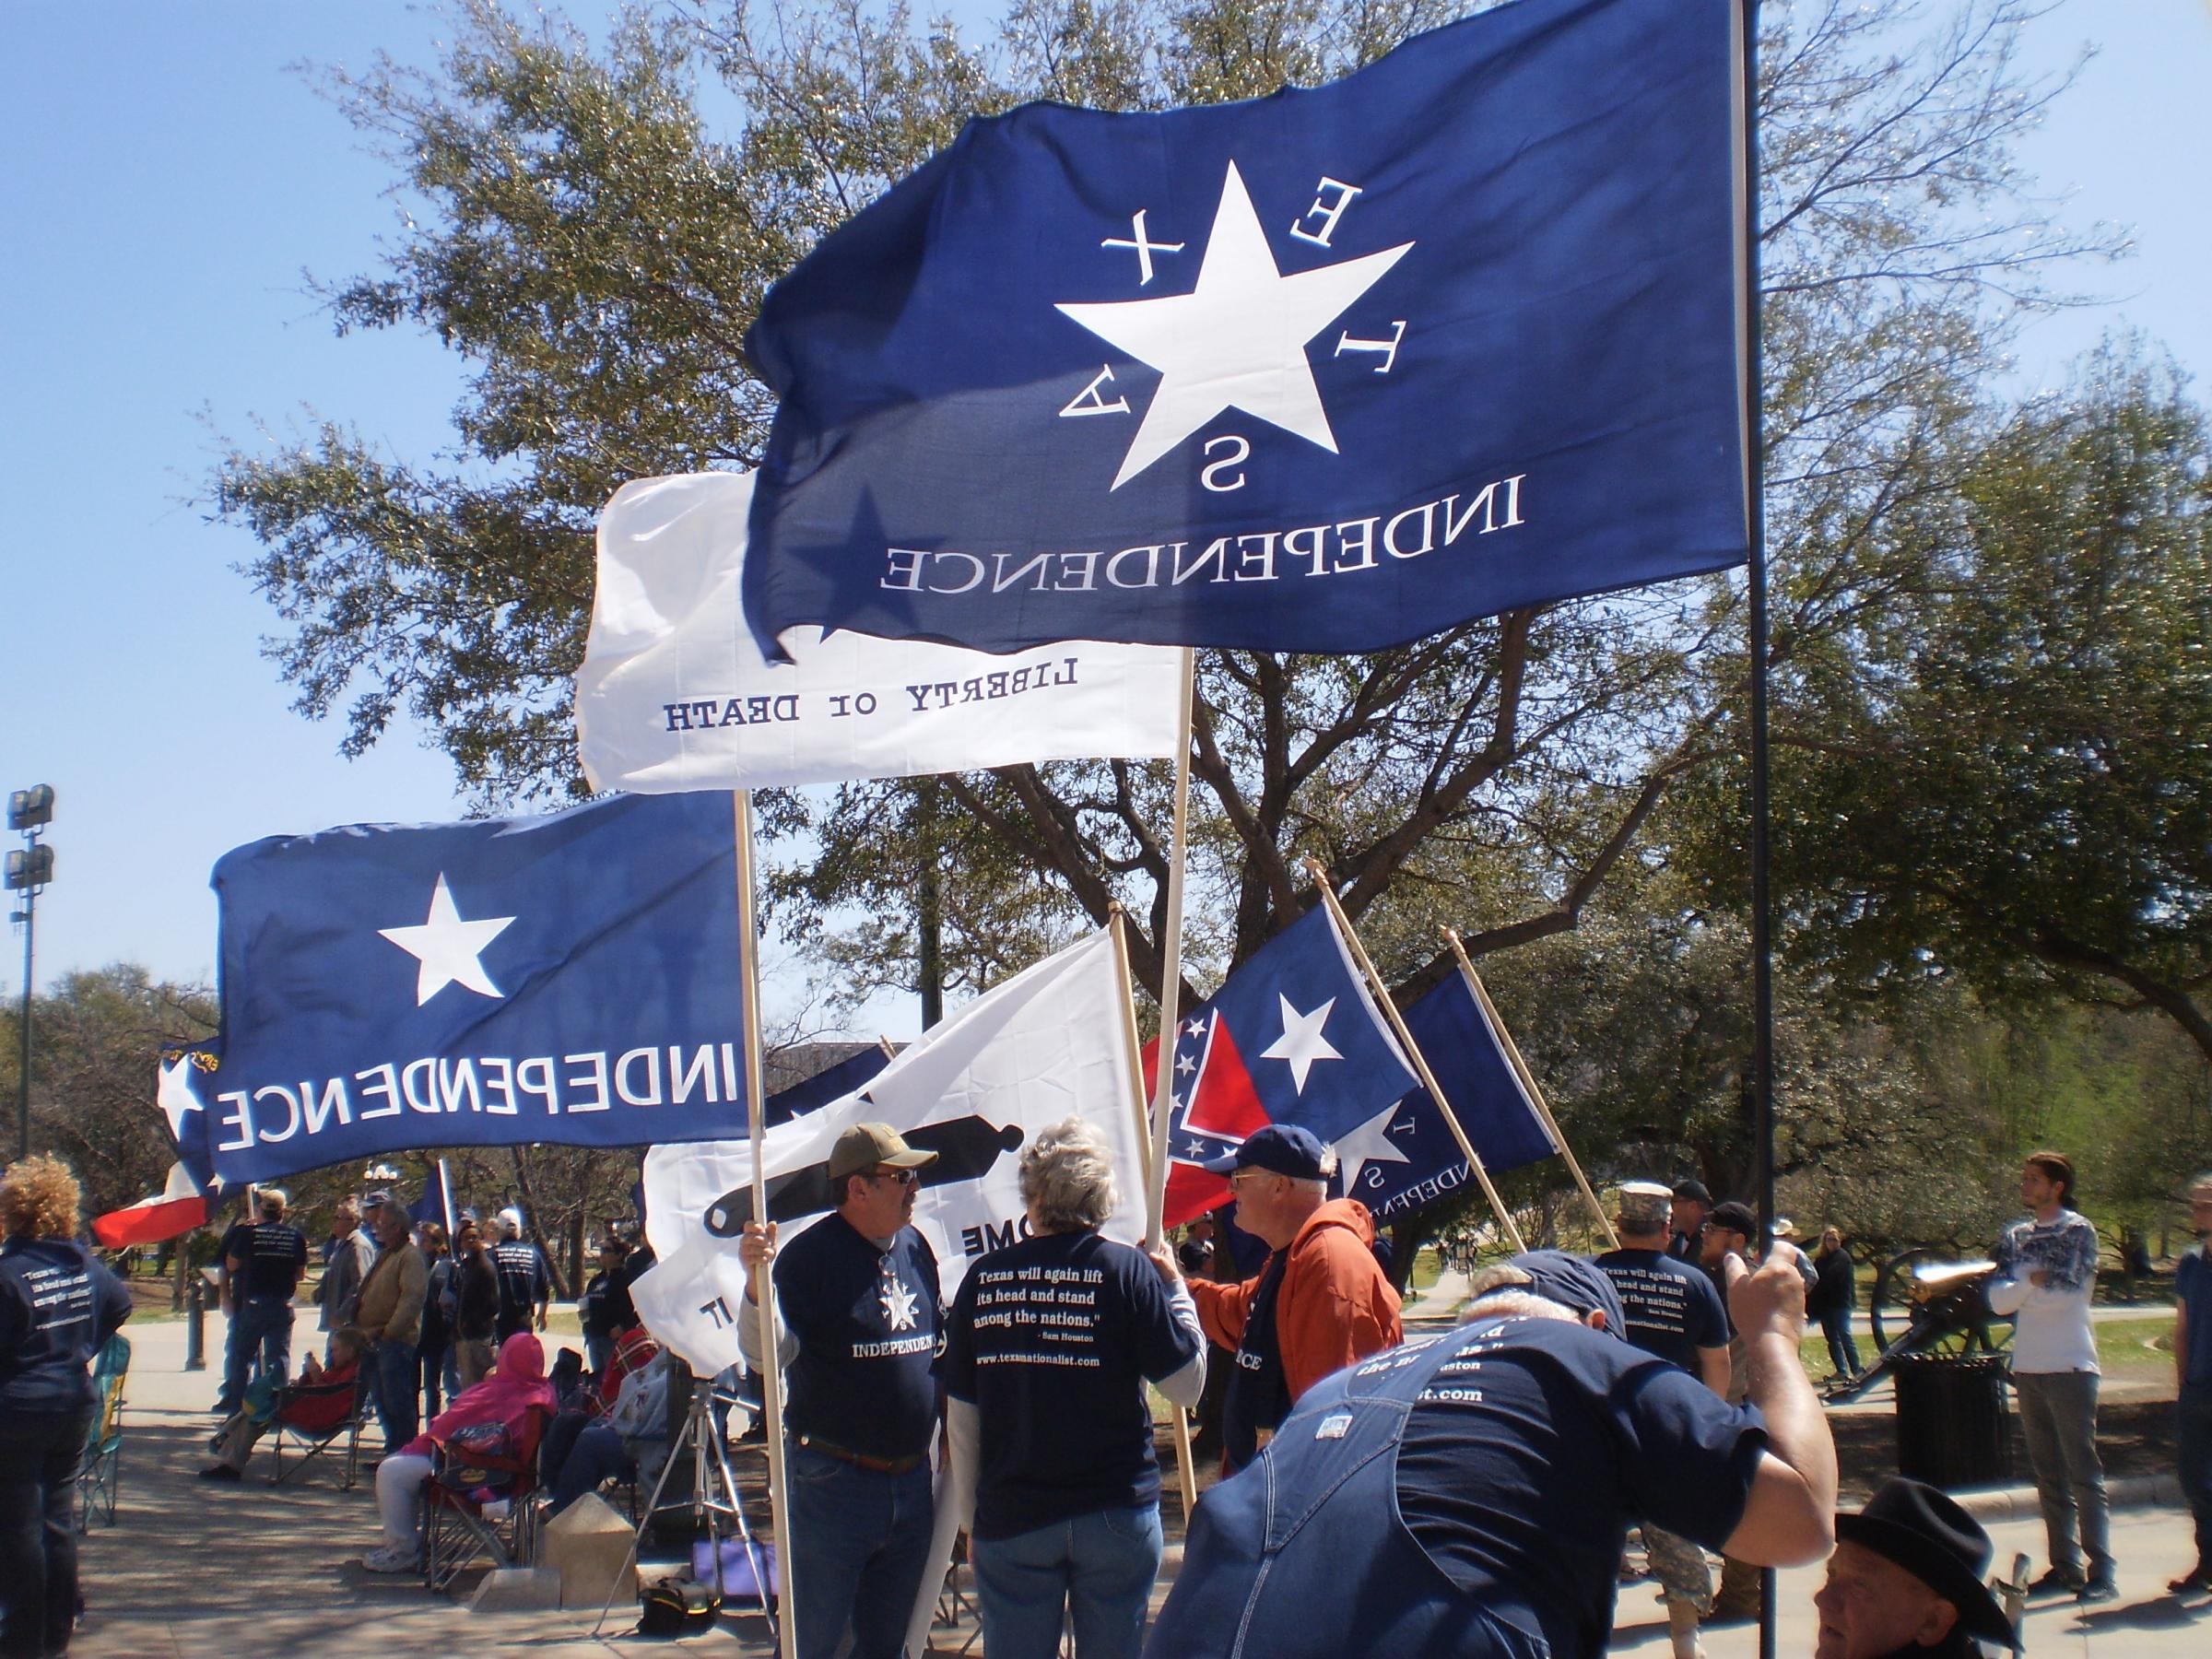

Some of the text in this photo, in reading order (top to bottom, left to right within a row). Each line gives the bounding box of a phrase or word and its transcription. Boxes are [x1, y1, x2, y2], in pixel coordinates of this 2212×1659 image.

[1018, 1266, 1041, 1280] will
[1044, 1266, 1080, 1284] again
[1083, 1269, 1103, 1284] lift
[1630, 1269, 1647, 1278] will
[1649, 1271, 1672, 1282] again
[1674, 1274, 1688, 1285] lift
[976, 1288, 1095, 1306] its head and stand
[1617, 1279, 1684, 1297] head and stand
[1630, 1294, 1645, 1304] the
[1016, 1309, 1038, 1324] the
[1041, 1312, 1100, 1327] nations."
[852, 1334, 937, 1358] INDEPENDEN
[1042, 1332, 1059, 1341] Sam
[1061, 1333, 1094, 1343] Houston
